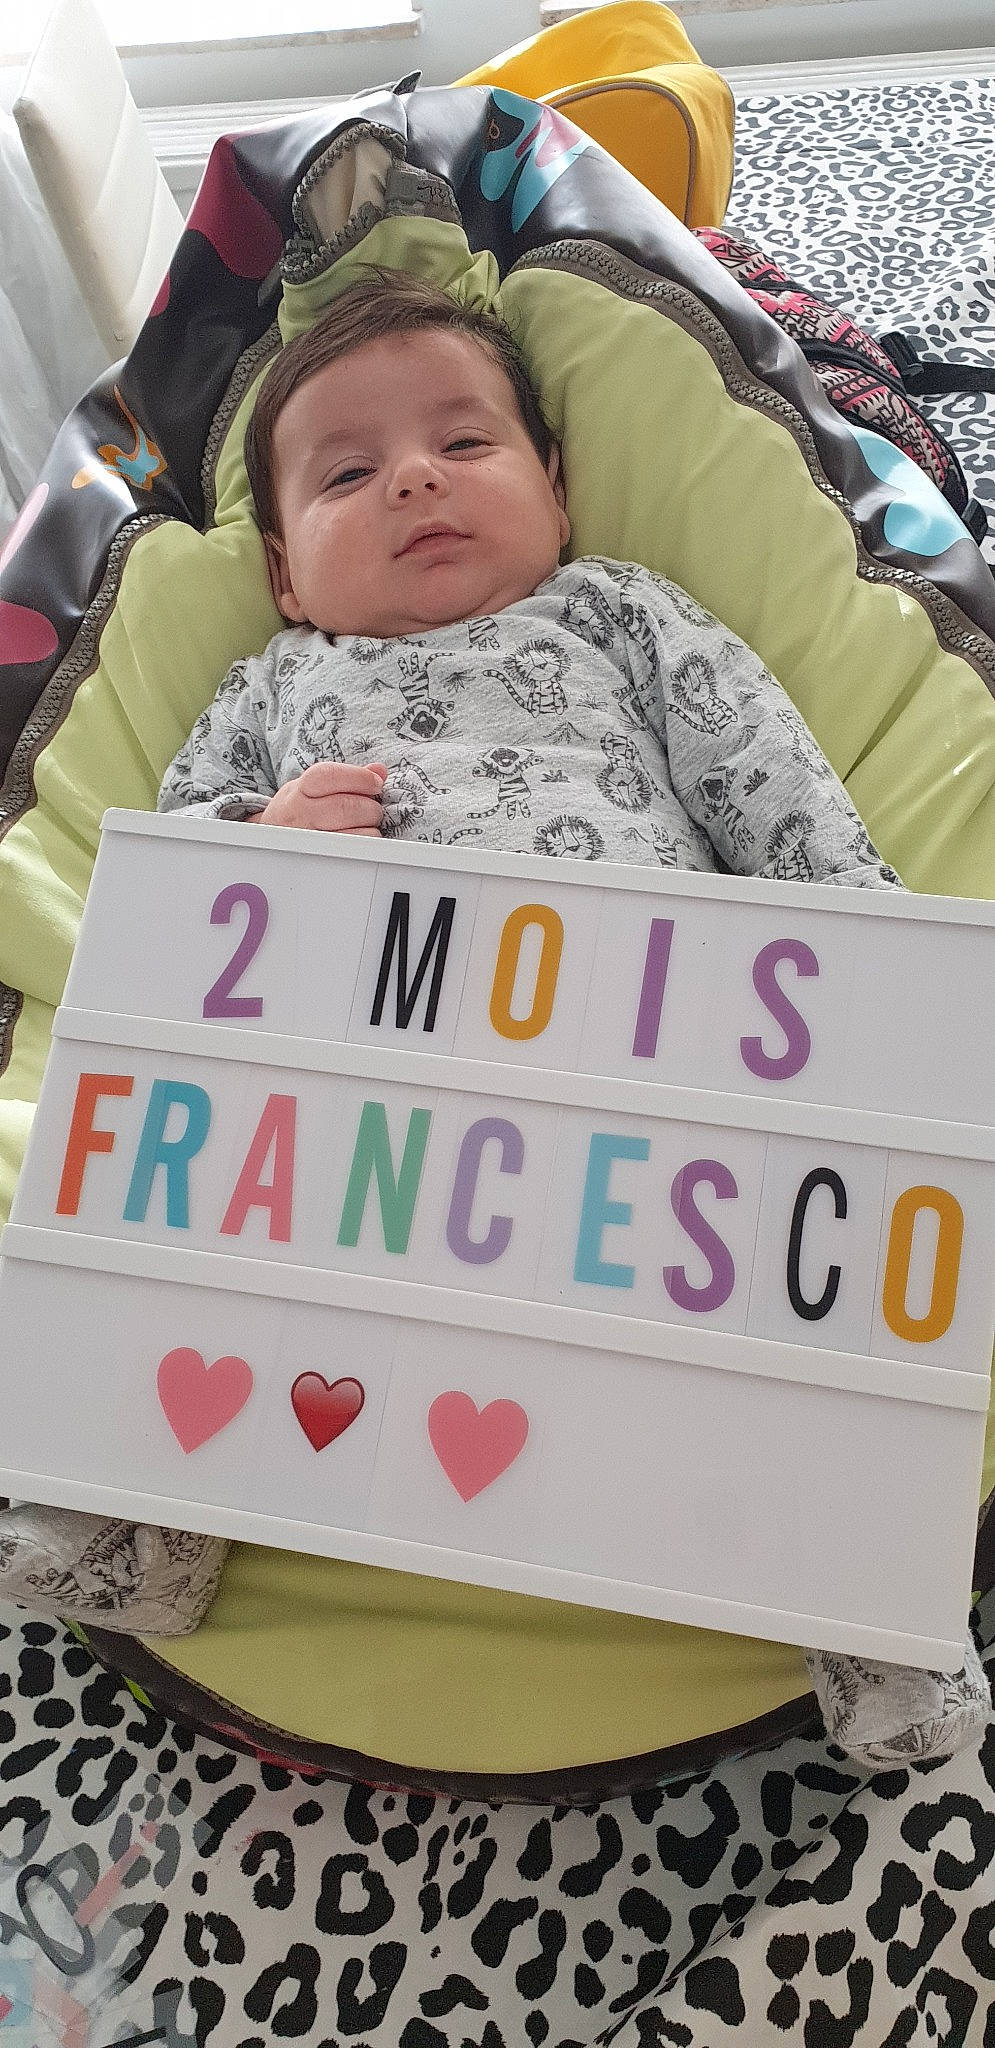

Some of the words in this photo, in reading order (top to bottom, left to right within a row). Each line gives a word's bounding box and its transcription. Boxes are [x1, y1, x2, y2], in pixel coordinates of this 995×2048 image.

[202, 882, 271, 1018] 2
[369, 891, 820, 1081] MOIS
[55, 1072, 966, 1344] FRANCESCO
